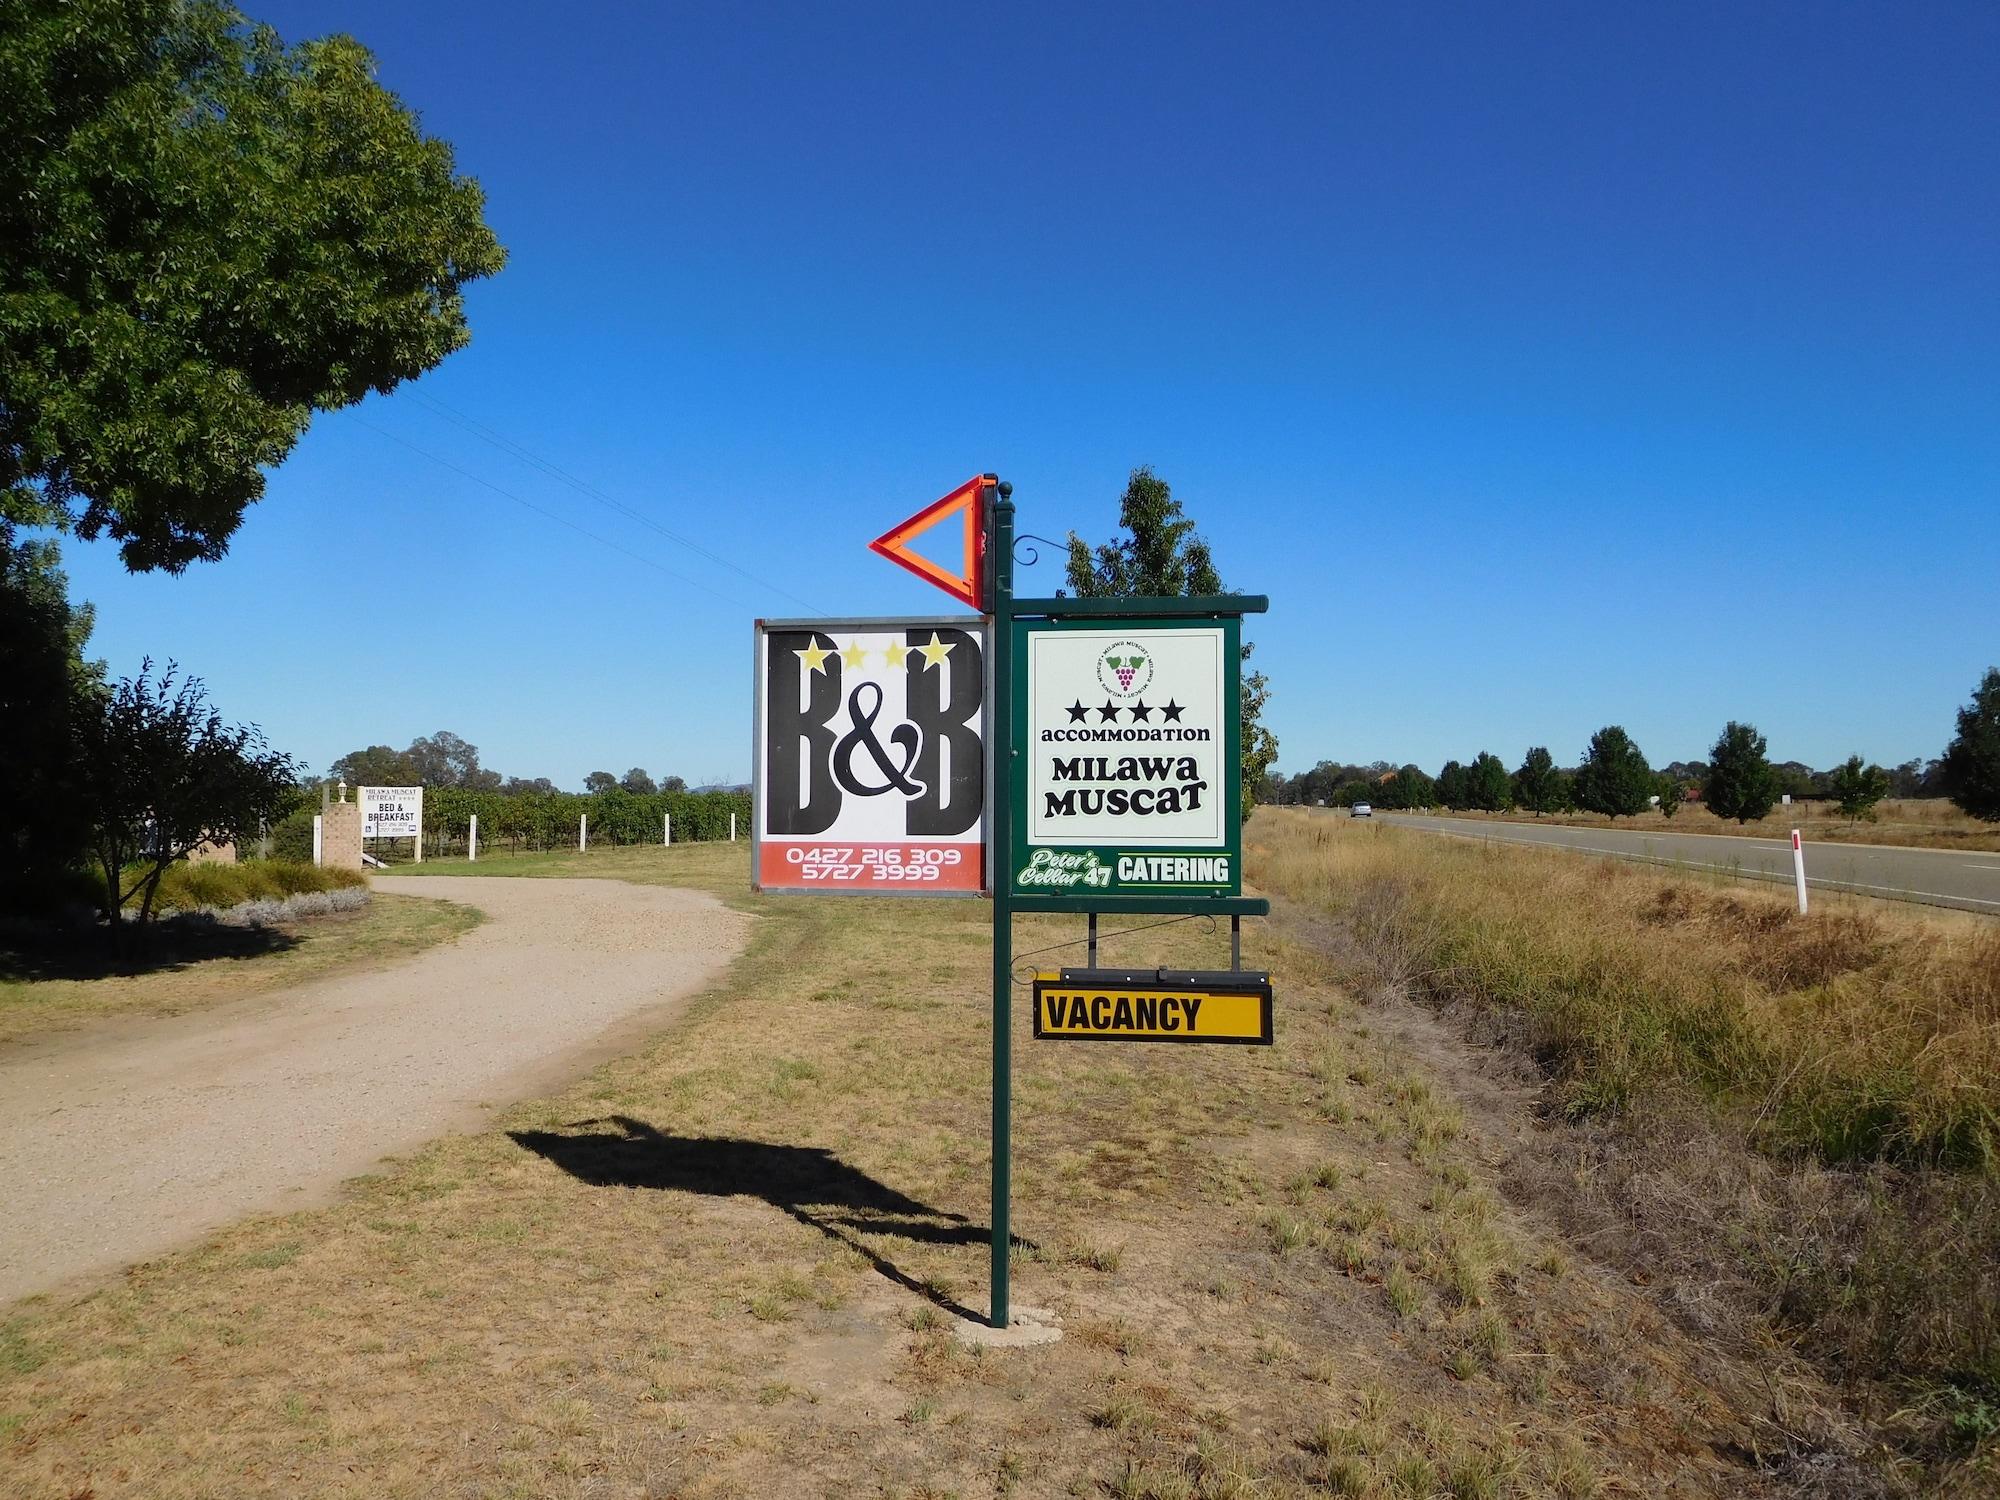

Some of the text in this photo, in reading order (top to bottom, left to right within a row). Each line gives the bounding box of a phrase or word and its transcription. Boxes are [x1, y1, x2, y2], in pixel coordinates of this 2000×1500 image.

[378, 803, 403, 812] BED &
[368, 812, 414, 822] BREAKFAST
[786, 848, 961, 865] 0427 216 309
[1030, 850, 1099, 869] Peter's
[802, 864, 940, 881] 5727 3999
[1018, 867, 1112, 886] Cellar 47
[1118, 857, 1229, 882] CATERING
[1046, 996, 1202, 1031] VACANCY
